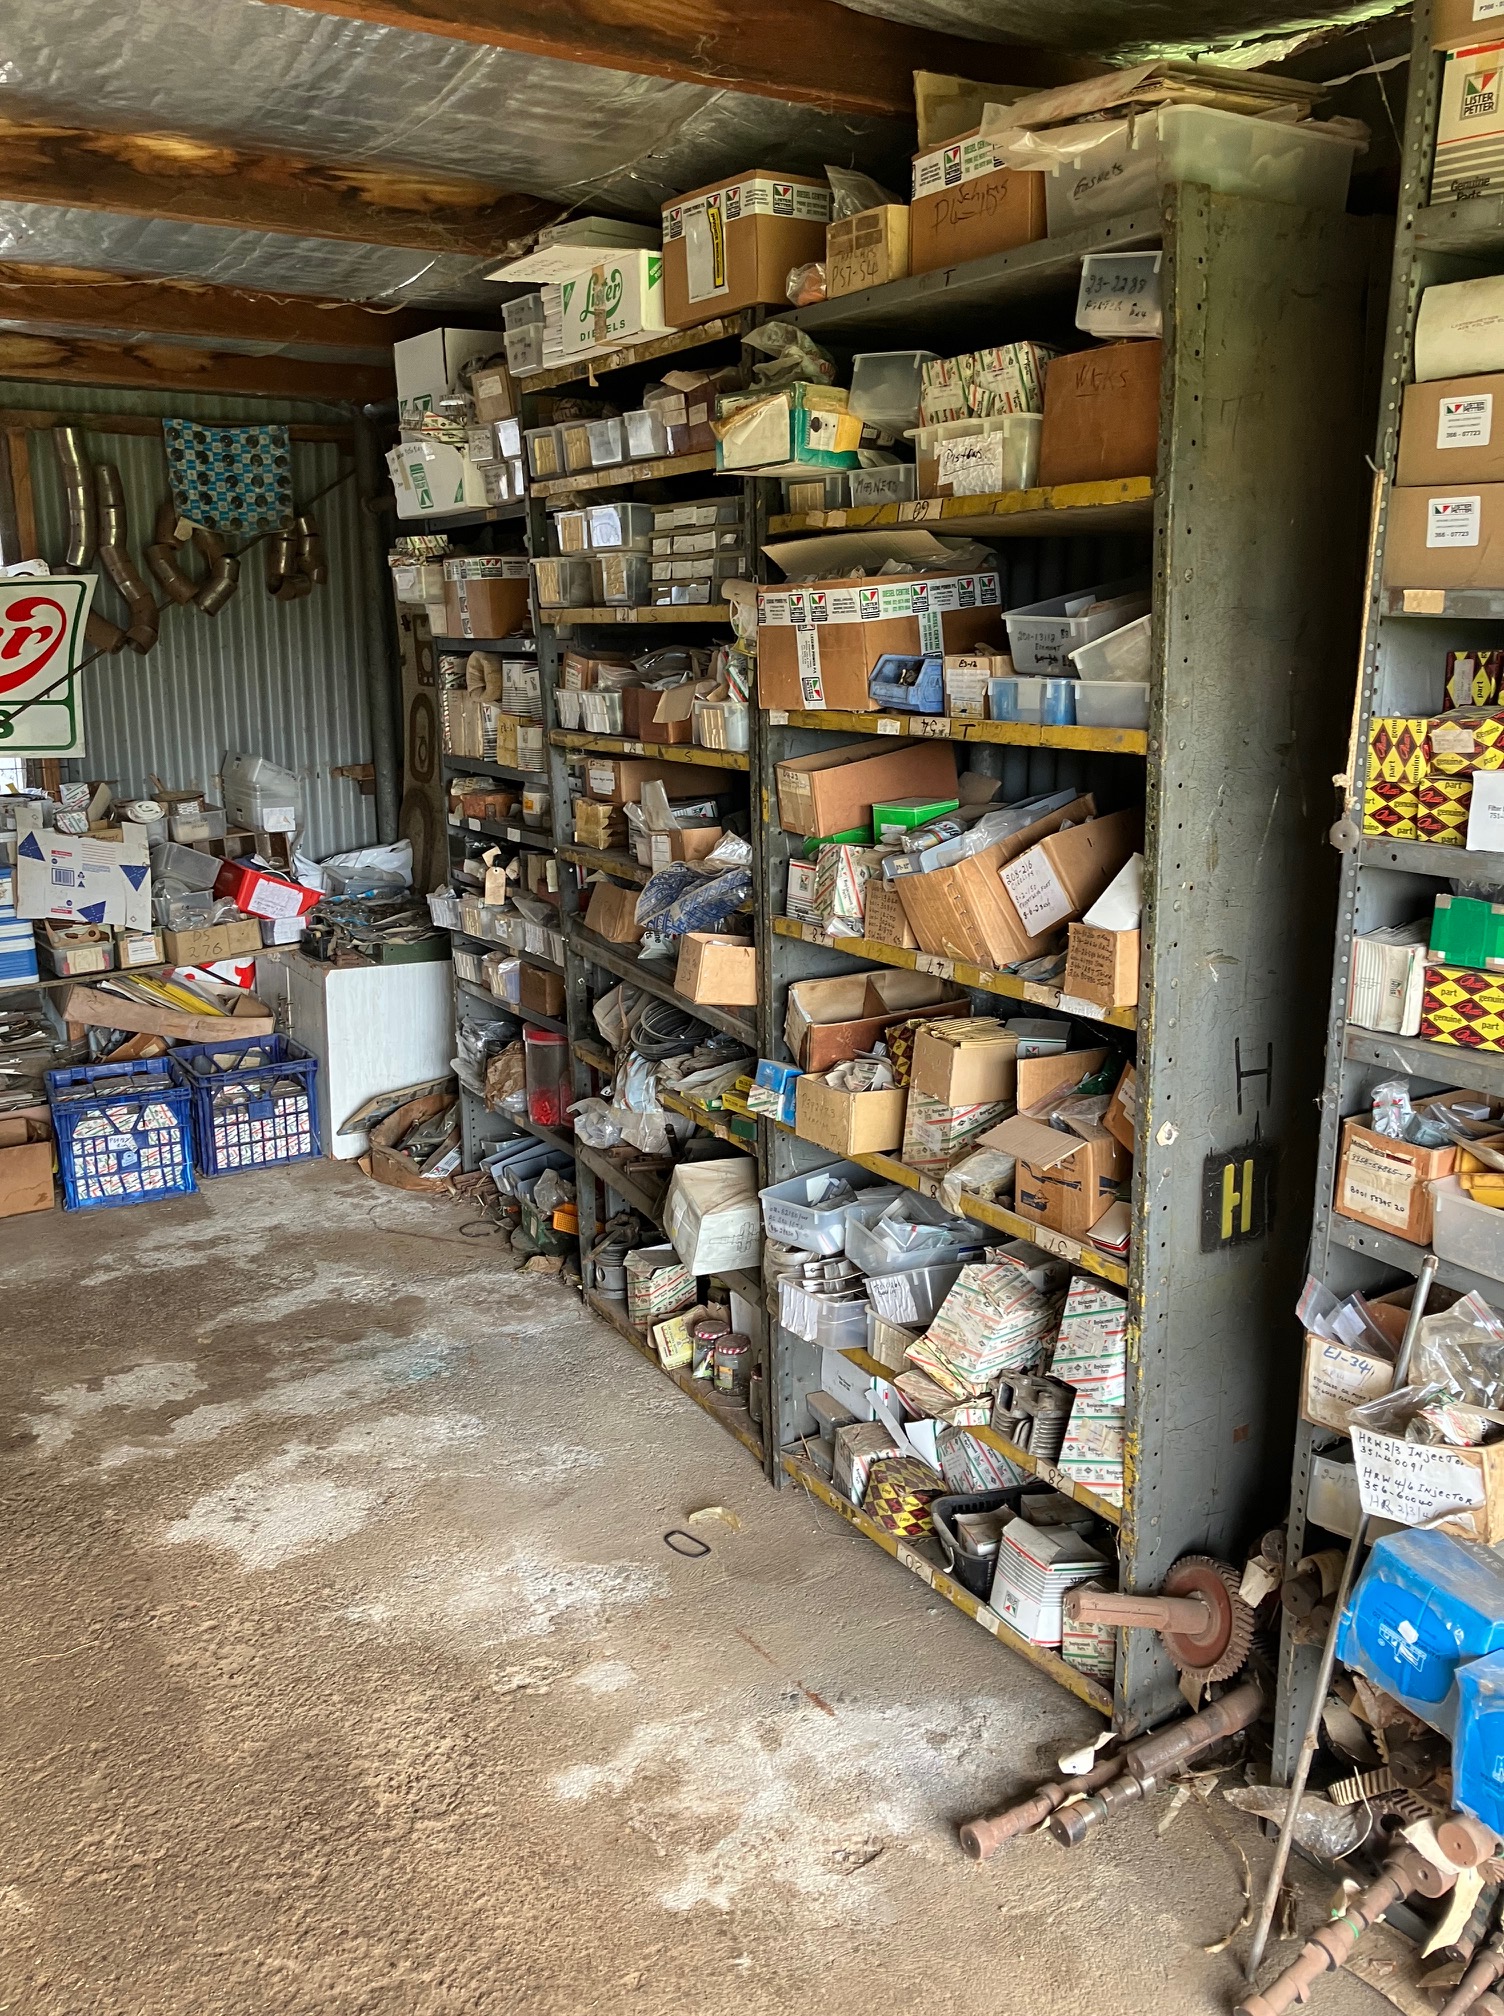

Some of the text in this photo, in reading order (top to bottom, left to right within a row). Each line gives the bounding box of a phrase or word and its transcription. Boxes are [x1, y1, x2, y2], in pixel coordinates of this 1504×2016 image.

[1464, 92, 1494, 106] LISTER
[1463, 101, 1494, 116] PETTER
[1451, 176, 1490, 193] Genuine
[1476, 681, 1484, 698] part
[1476, 726, 1500, 740] genuine
[1436, 756, 1464, 766] genuine
[1483, 754, 1498, 766] part
[1388, 760, 1396, 778] part
[1444, 780, 1463, 789] part
[1437, 808, 1466, 818] genuine
[1397, 827, 1413, 836] part
[1441, 836, 1458, 845] part
[192, 930, 210, 942] DS
[187, 942, 223, 958] 276
[1441, 989, 1458, 997] part
[1433, 1014, 1500, 1031] genuine part
[1234, 1036, 1273, 1116] H
[1221, 1159, 1254, 1240] H
[1077, 1298, 1098, 1306] Replacement
[1094, 1318, 1114, 1326] Replacement
[1000, 1332, 1024, 1344] Replacement
[1358, 1430, 1382, 1449] HRW
[1363, 1466, 1391, 1484] HRW
